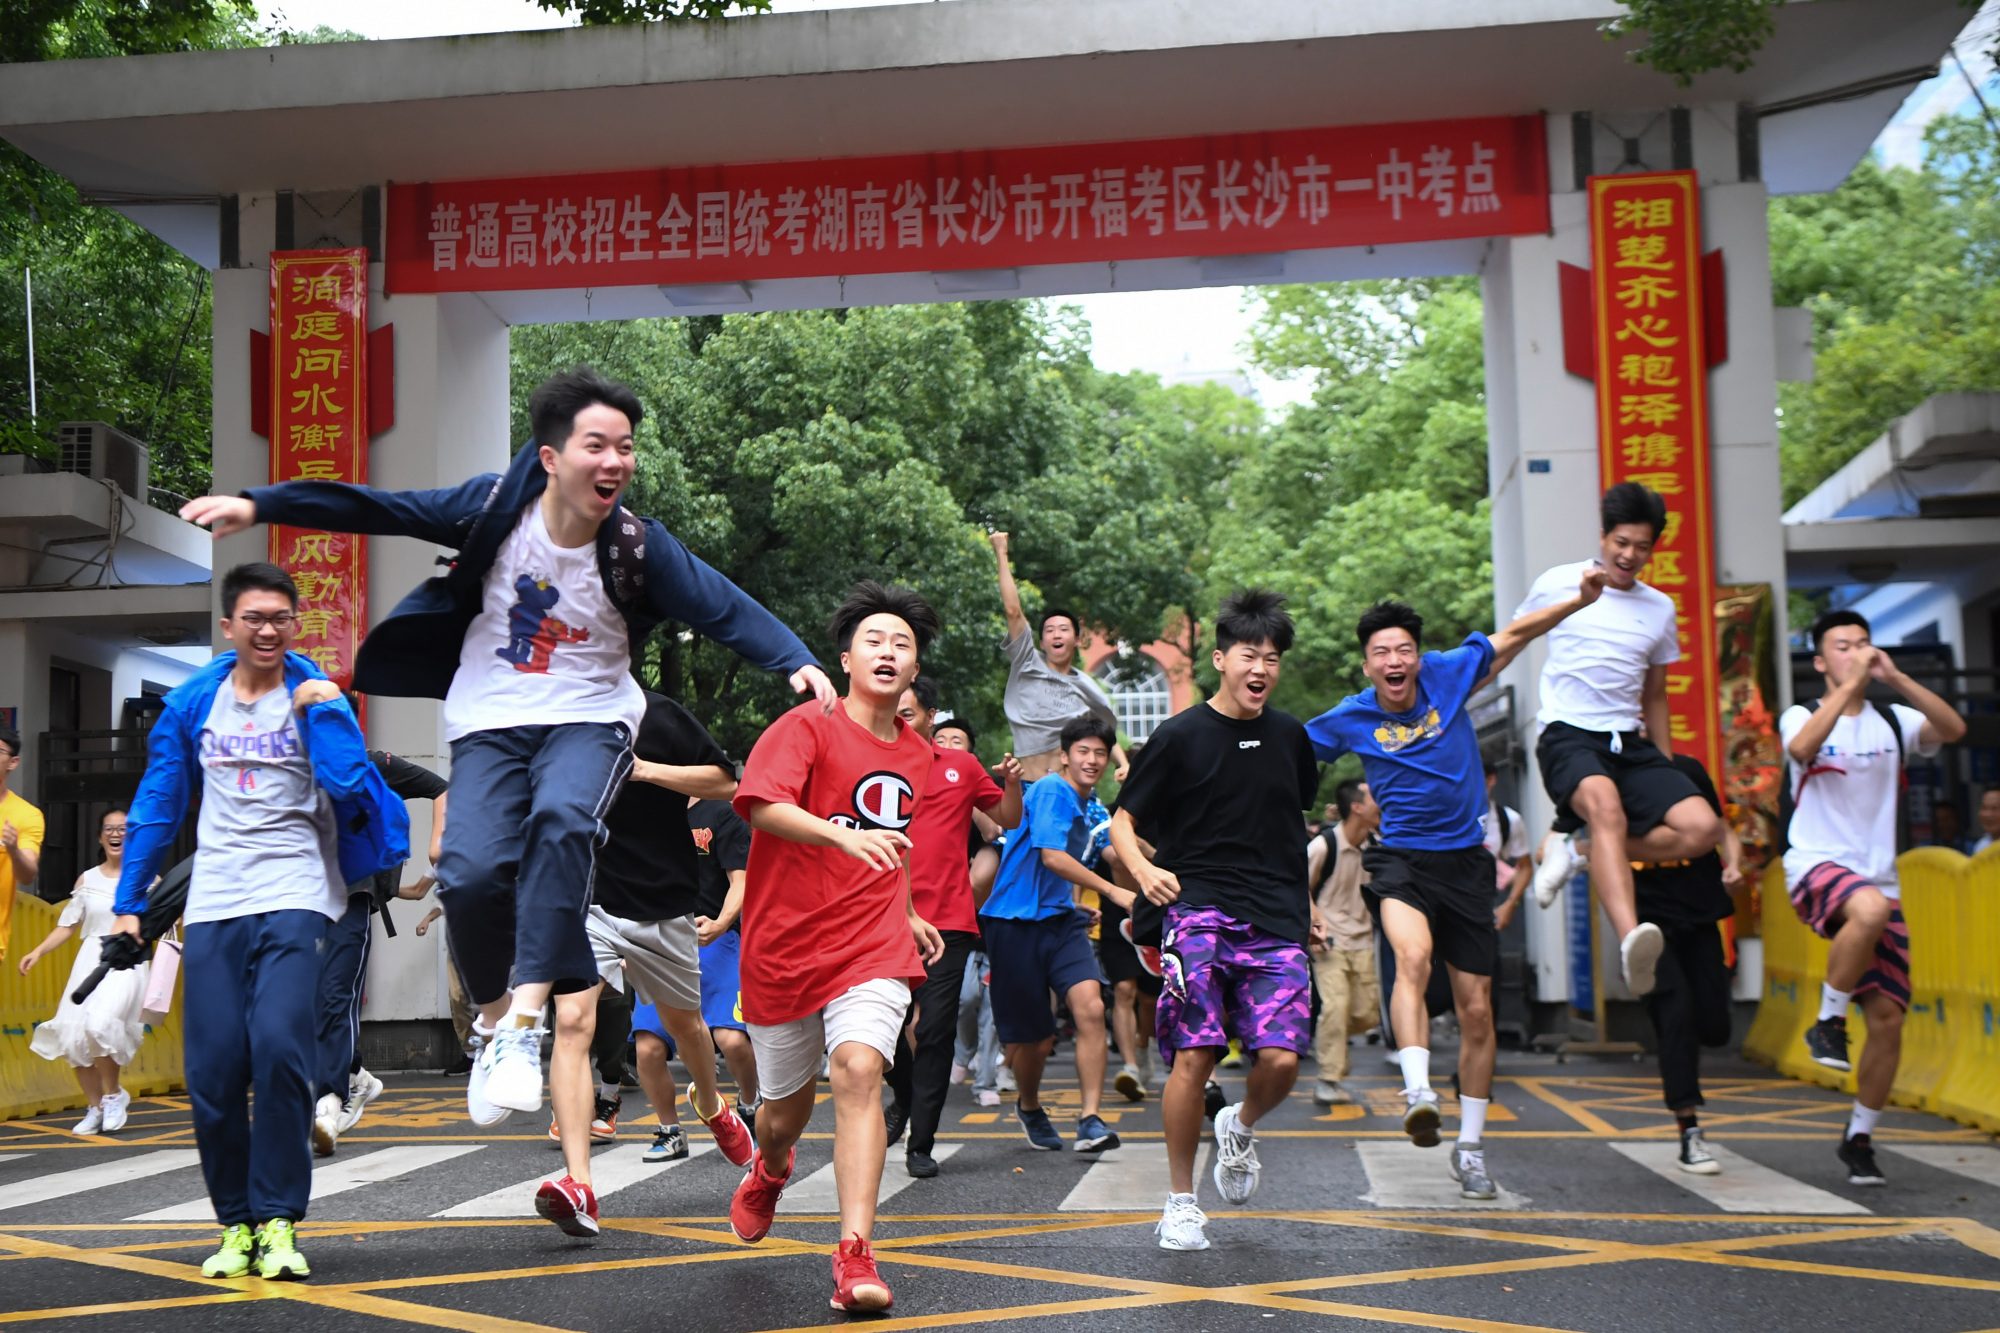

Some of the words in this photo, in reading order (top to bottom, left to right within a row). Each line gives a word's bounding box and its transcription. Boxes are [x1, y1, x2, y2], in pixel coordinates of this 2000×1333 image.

[428, 141, 1501, 271] 普通高校招生全国统考湖南省长沙市开福考区长沙市一中考点
